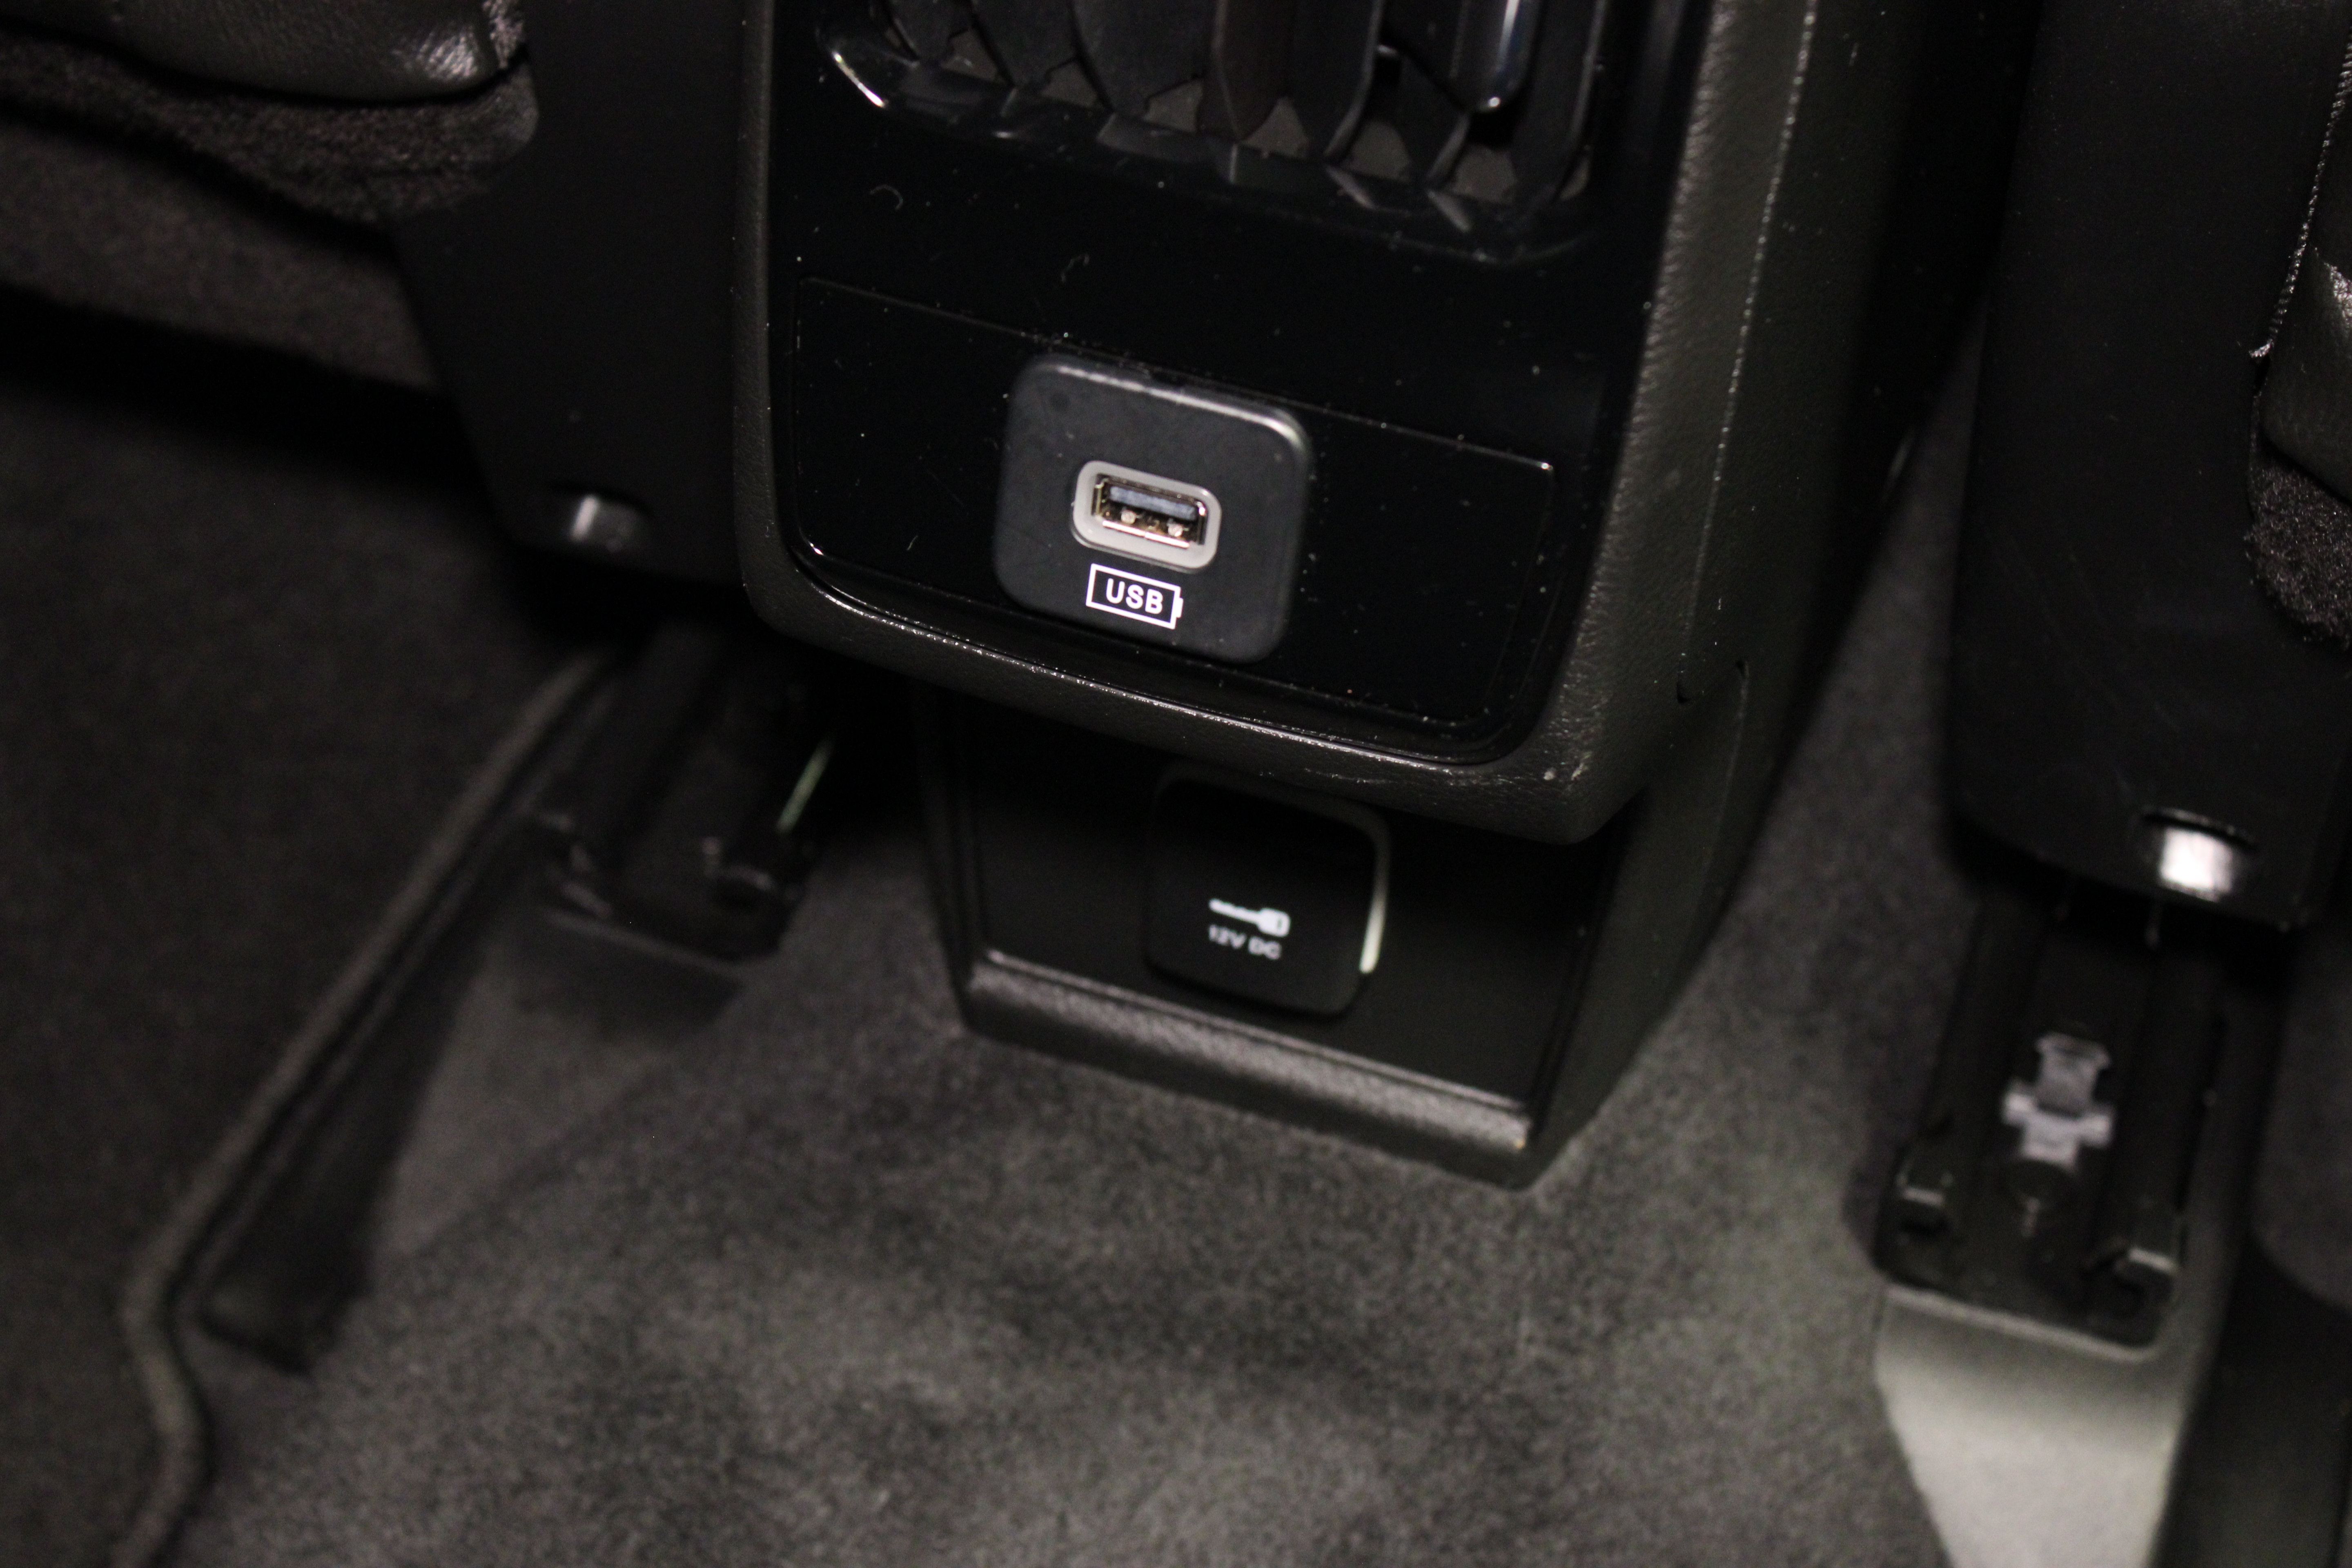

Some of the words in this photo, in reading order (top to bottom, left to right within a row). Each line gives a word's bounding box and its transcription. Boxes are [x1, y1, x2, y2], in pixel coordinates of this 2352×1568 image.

[1105, 577, 1164, 615] USB
[1209, 924, 1246, 949] 12V
[1248, 936, 1281, 960] DC
